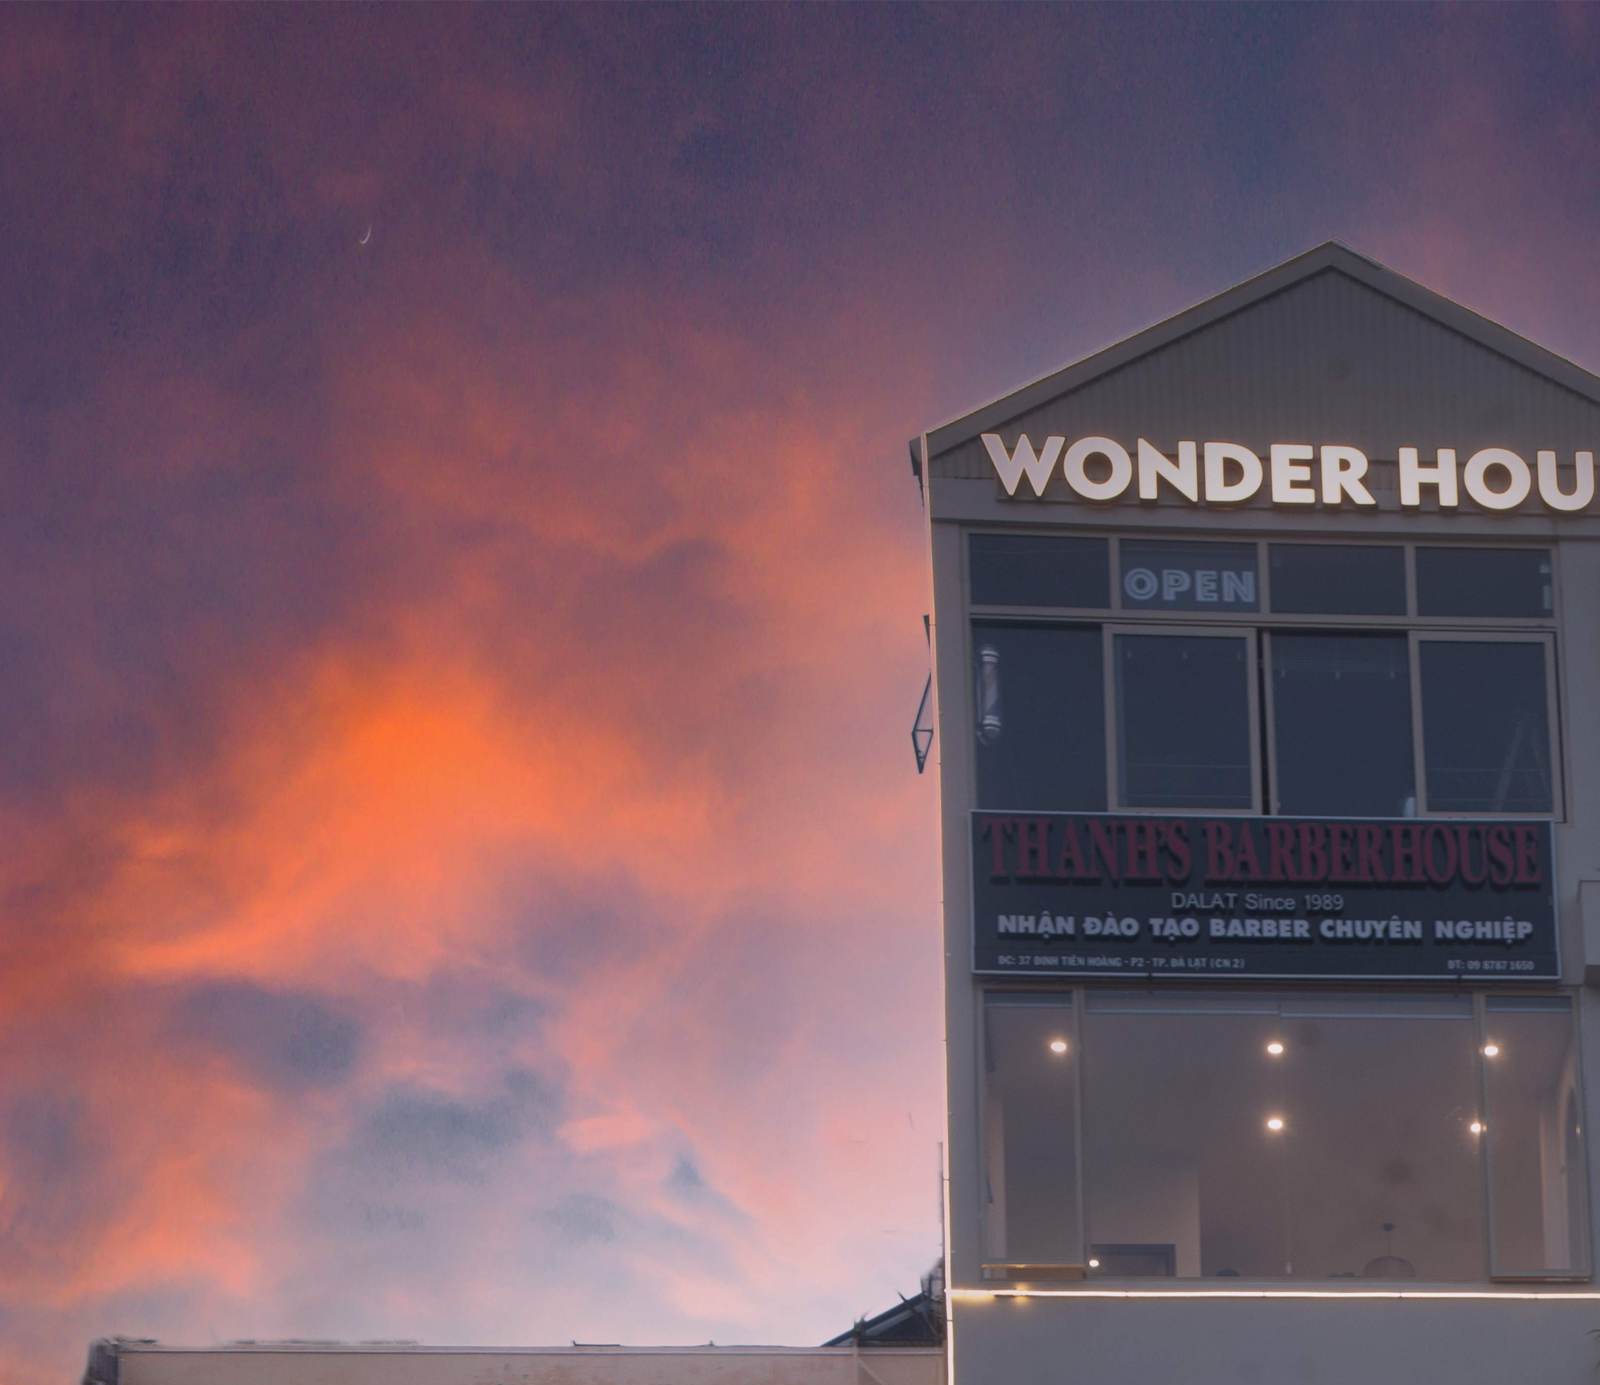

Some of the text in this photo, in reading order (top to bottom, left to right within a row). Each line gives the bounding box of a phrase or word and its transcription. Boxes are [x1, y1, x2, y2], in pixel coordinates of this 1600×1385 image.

[983, 434, 1594, 511] WONDER HOU
[1123, 567, 1256, 603] OPEN
[1171, 892, 1344, 911] DALAT Since 1989
[997, 910, 1533, 944] NHẬN ĐÀO TẠO BARBER CHUYÊN NGHIỆP
[1018, 956, 1032, 966] 37
